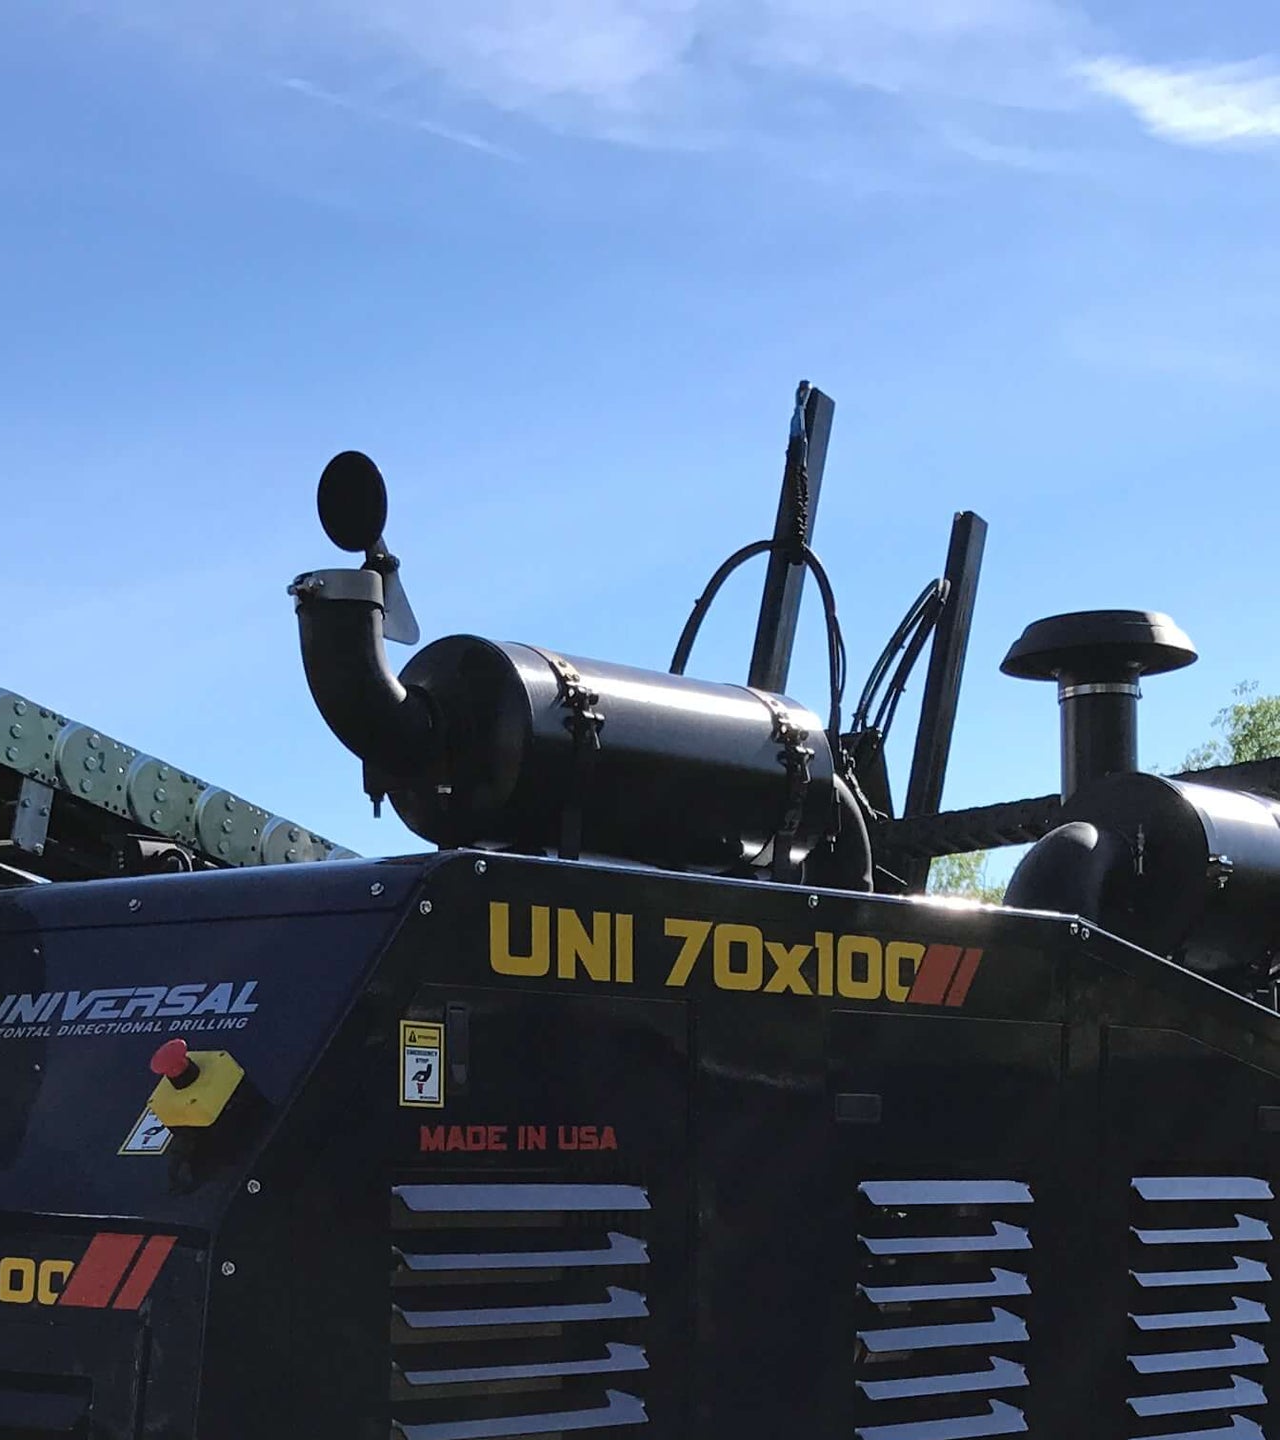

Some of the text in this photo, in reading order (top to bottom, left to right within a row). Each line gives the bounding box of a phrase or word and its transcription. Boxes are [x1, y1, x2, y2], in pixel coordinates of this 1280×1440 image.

[489, 901, 926, 1004] UNI 70x100
[57, 1020, 162, 1037] DIRECTIONAL
[169, 1016, 248, 1032] DRILLING
[420, 1125, 618, 1151] MADE IN USA
